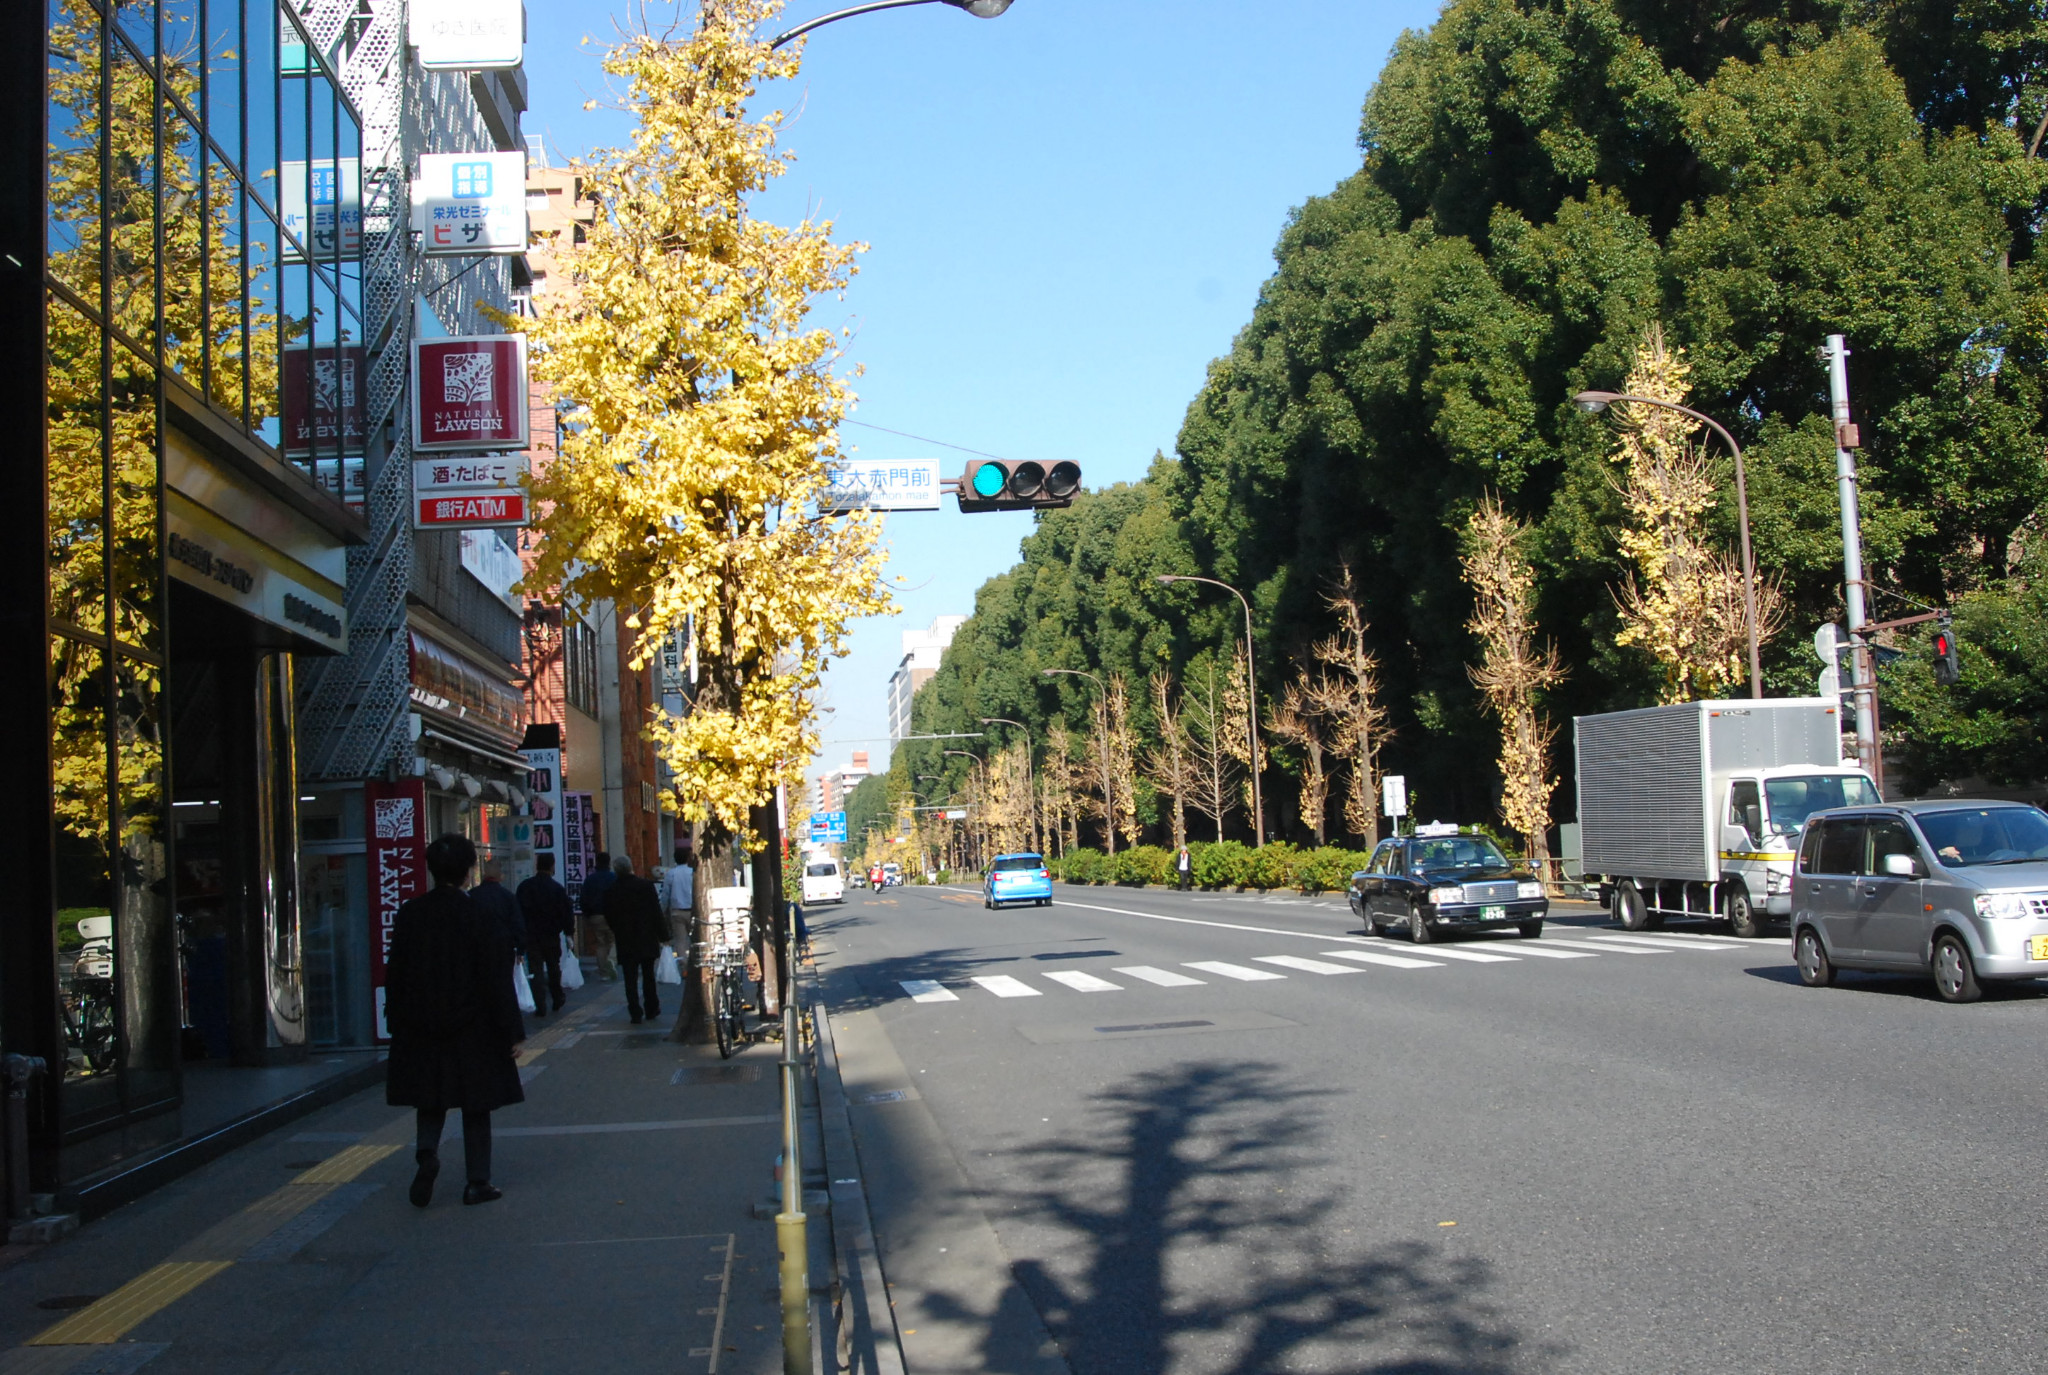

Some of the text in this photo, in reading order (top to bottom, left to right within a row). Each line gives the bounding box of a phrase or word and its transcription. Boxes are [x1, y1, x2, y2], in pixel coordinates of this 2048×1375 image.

[433, 204, 512, 220] 栄光ゼミナール
[434, 410, 503, 421] NATURAL
[434, 418, 503, 433] LAWSON
[827, 468, 931, 489] 東大赤門前
[906, 491, 929, 501] mae
[435, 500, 506, 519] 銀行ATM
